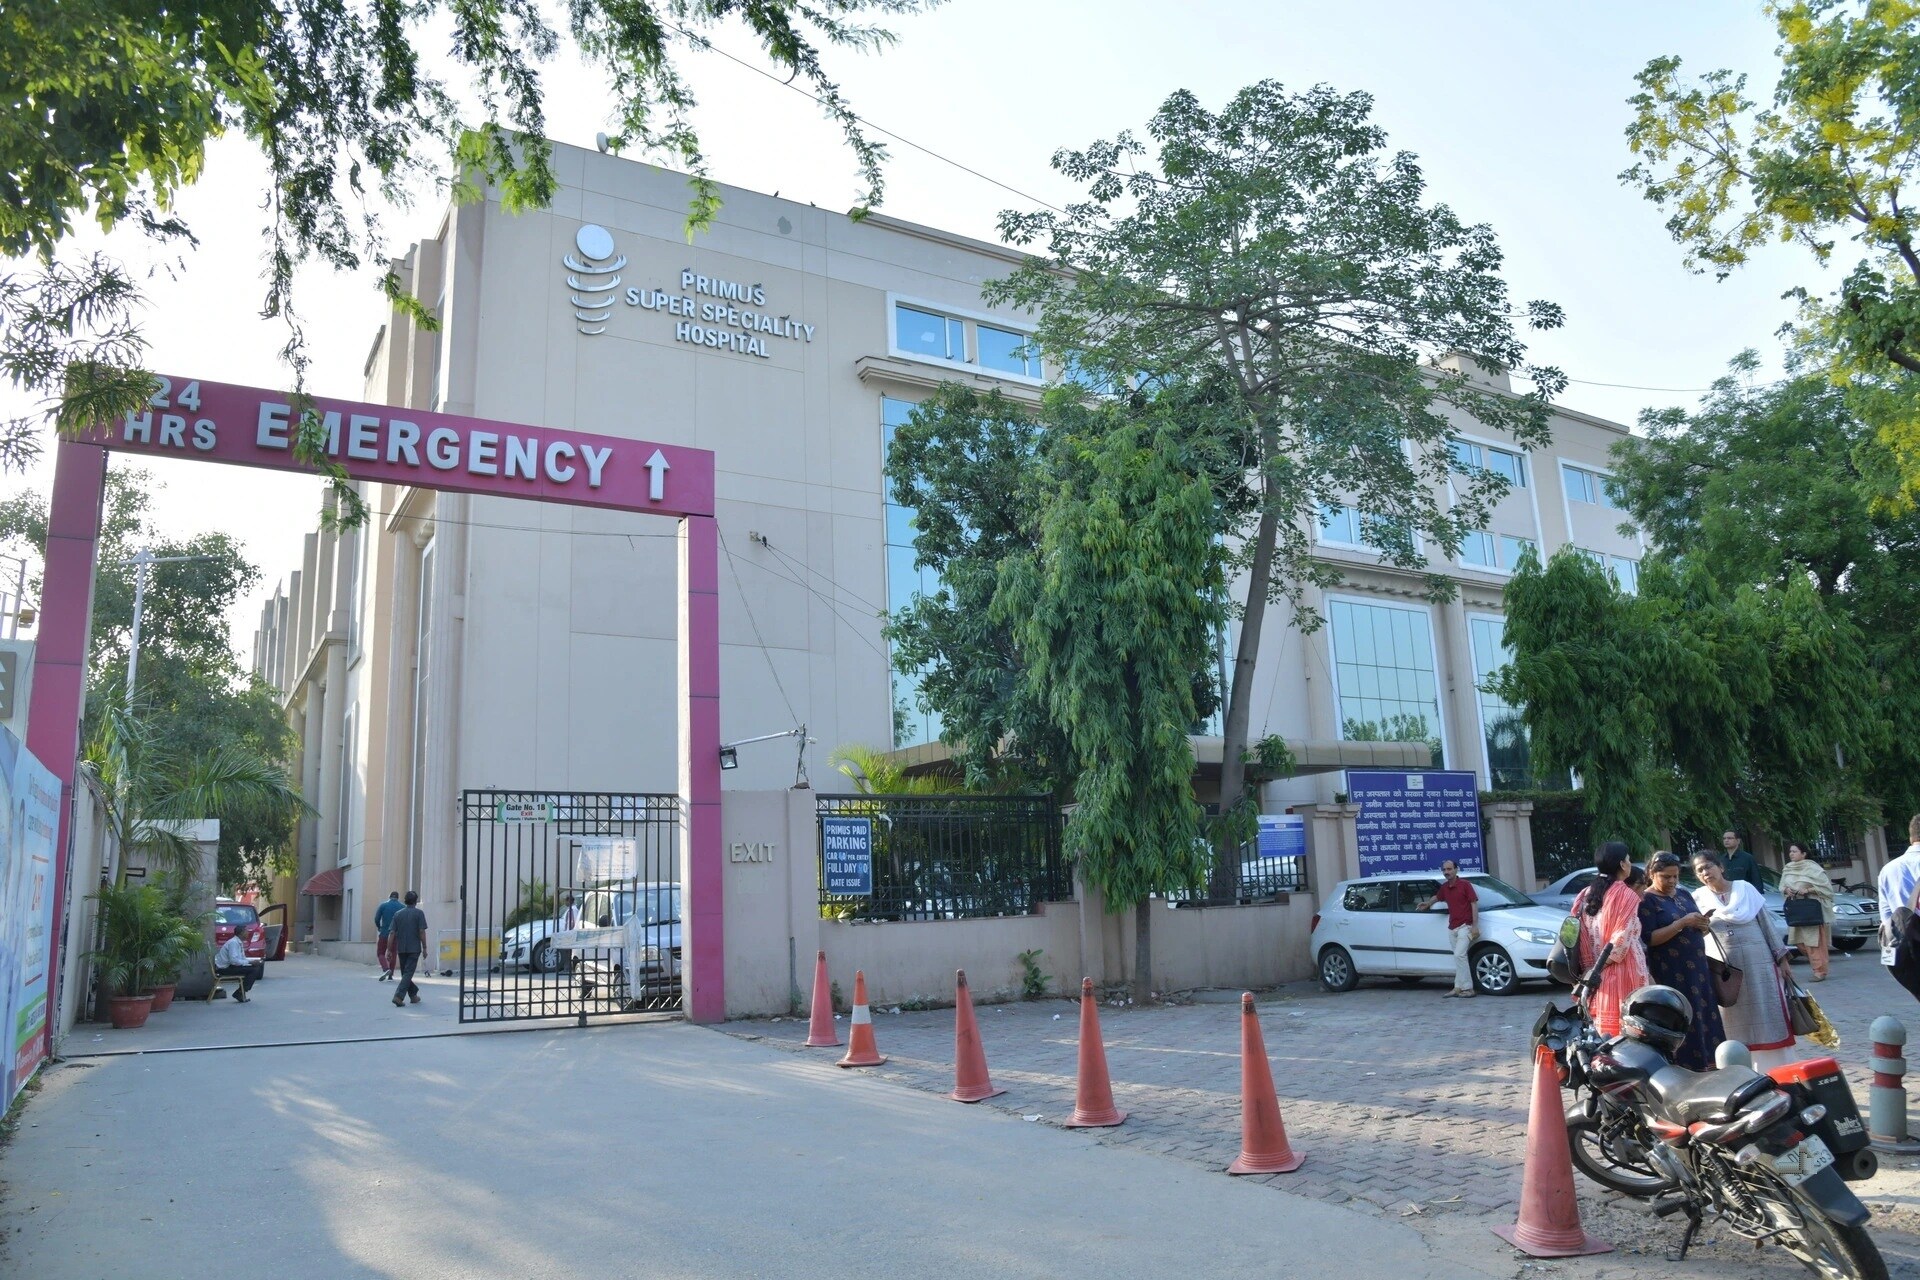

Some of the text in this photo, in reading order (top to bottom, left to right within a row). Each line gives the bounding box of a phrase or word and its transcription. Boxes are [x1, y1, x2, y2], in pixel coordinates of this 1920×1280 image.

[681, 271, 766, 306] PRIMUS
[625, 287, 815, 342] SUPER SPECIALITY
[676, 321, 770, 358] HOSPITAL
[148, 375, 201, 412] 24
[124, 409, 217, 450] HRS
[256, 401, 613, 488] EMERGENCY
[1393, 789, 1401, 797] को
[827, 825, 867, 835] PRIMUS PAID
[730, 842, 775, 864] EXIT
[827, 837, 866, 849] PARKING
[827, 852, 838, 860] CAR
[828, 863, 843, 873] FULL
[844, 863, 857, 873] DAY
[846, 879, 861, 887] ISSUE
